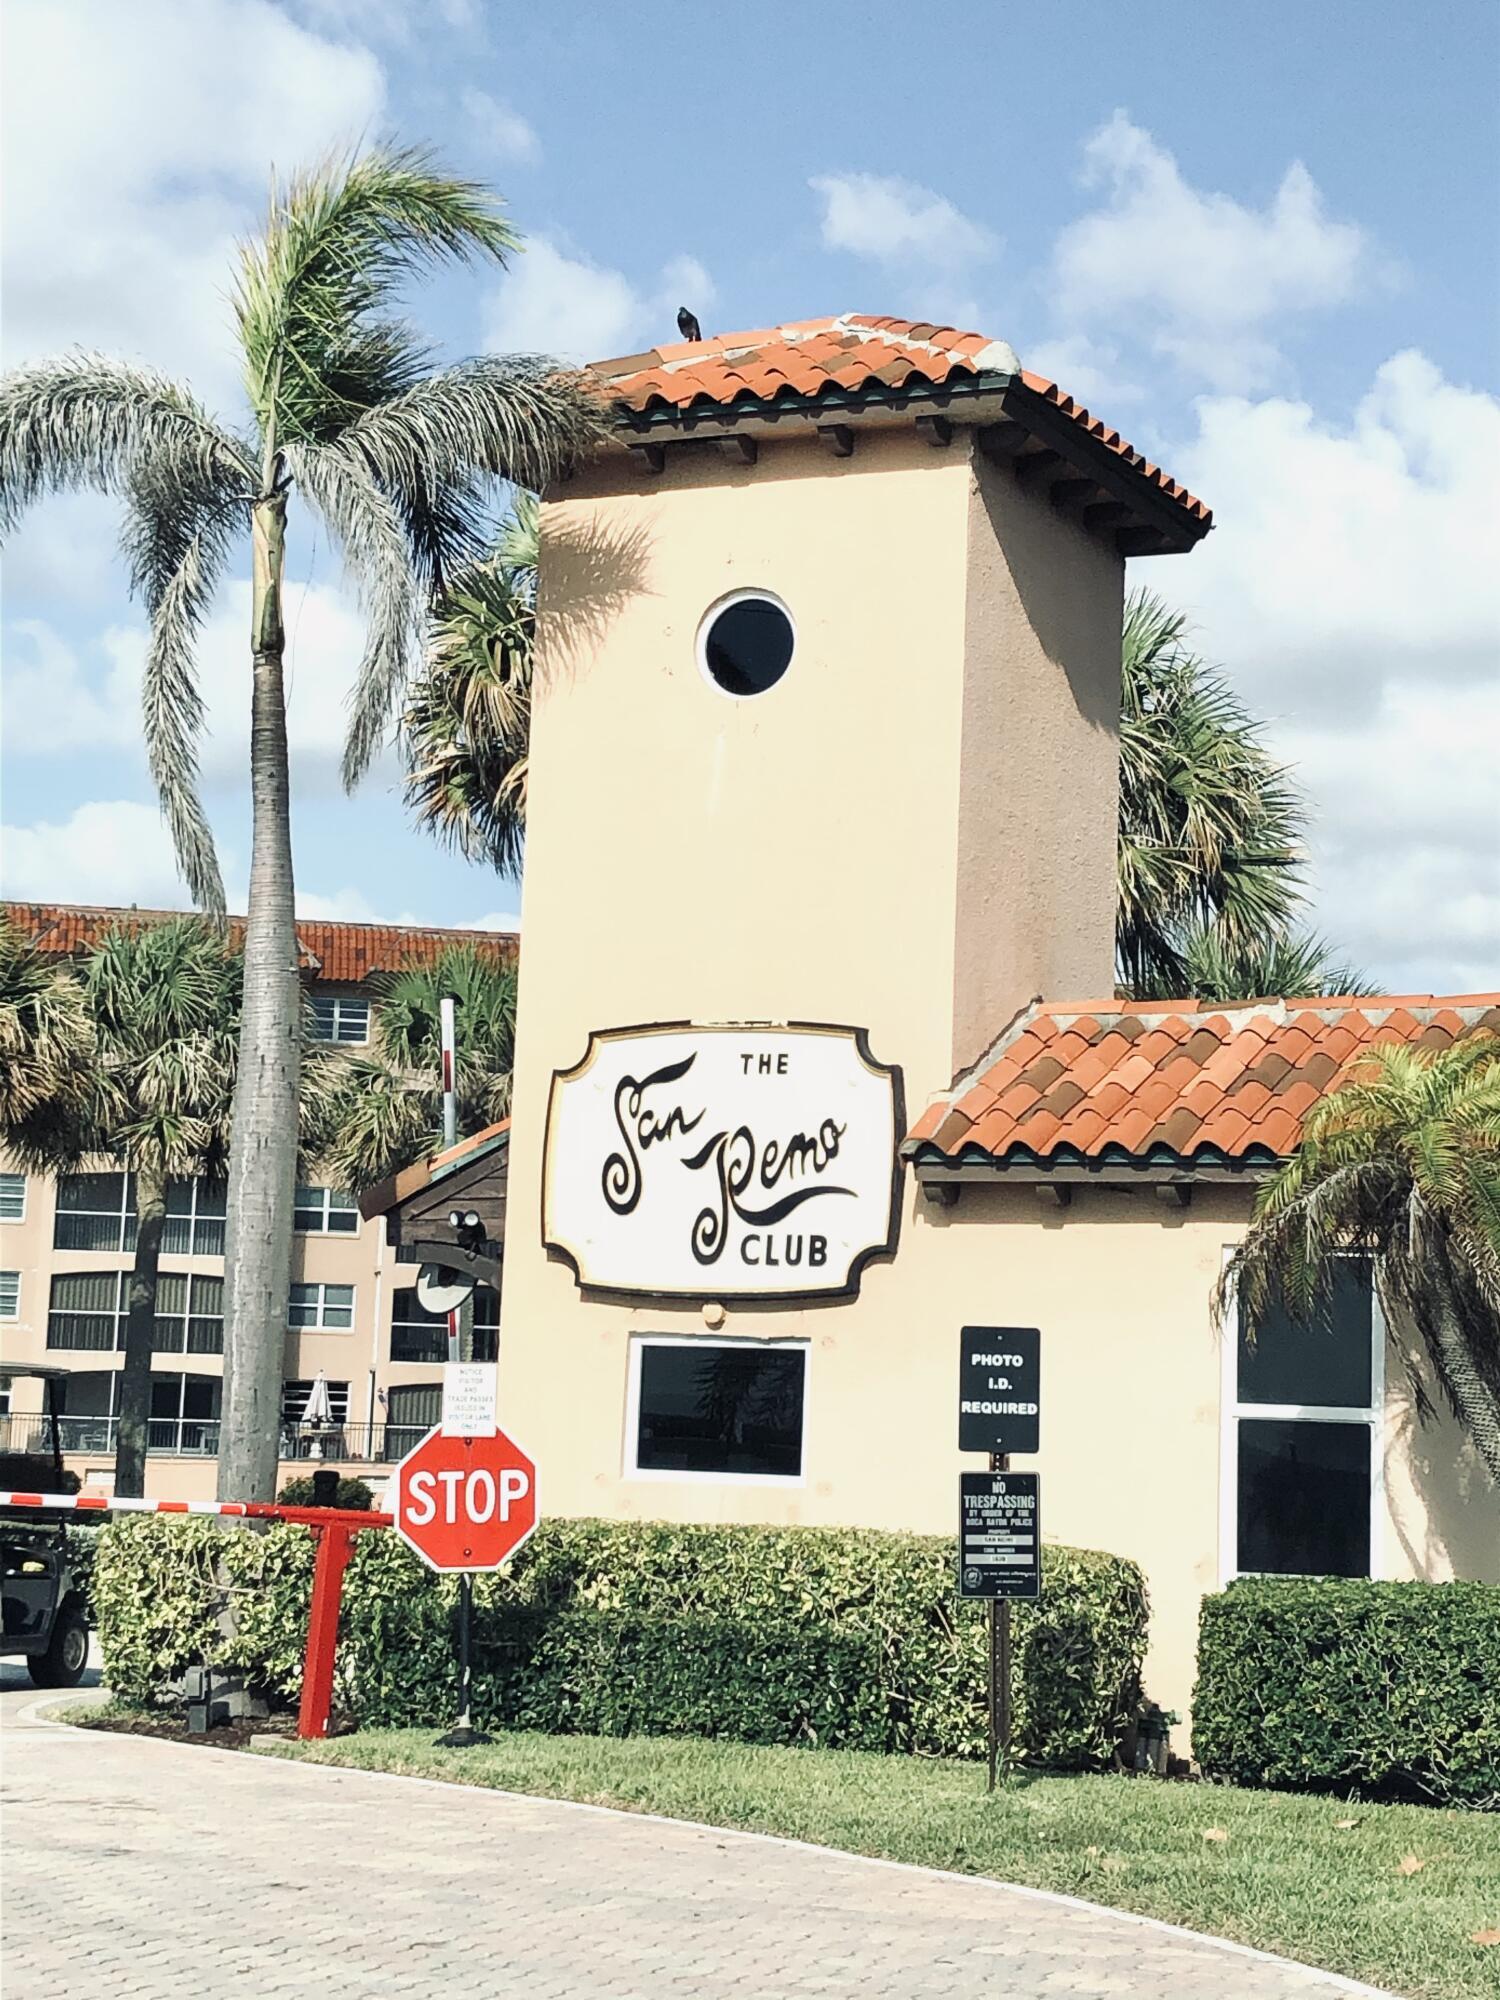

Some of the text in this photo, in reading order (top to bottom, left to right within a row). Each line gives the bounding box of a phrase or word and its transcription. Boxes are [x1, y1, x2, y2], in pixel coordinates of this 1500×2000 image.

[740, 1053, 790, 1076] THE
[602, 1051, 706, 1215] San
[740, 1233, 828, 1267] CLUB
[971, 1353, 1024, 1367] PHOTO
[988, 1376, 1013, 1390] I.D.
[961, 1400, 1038, 1415] REQUIRED
[991, 1481, 1006, 1494] NO
[405, 1469, 529, 1526] STOP
[963, 1494, 1036, 1509] TRESPASSING
